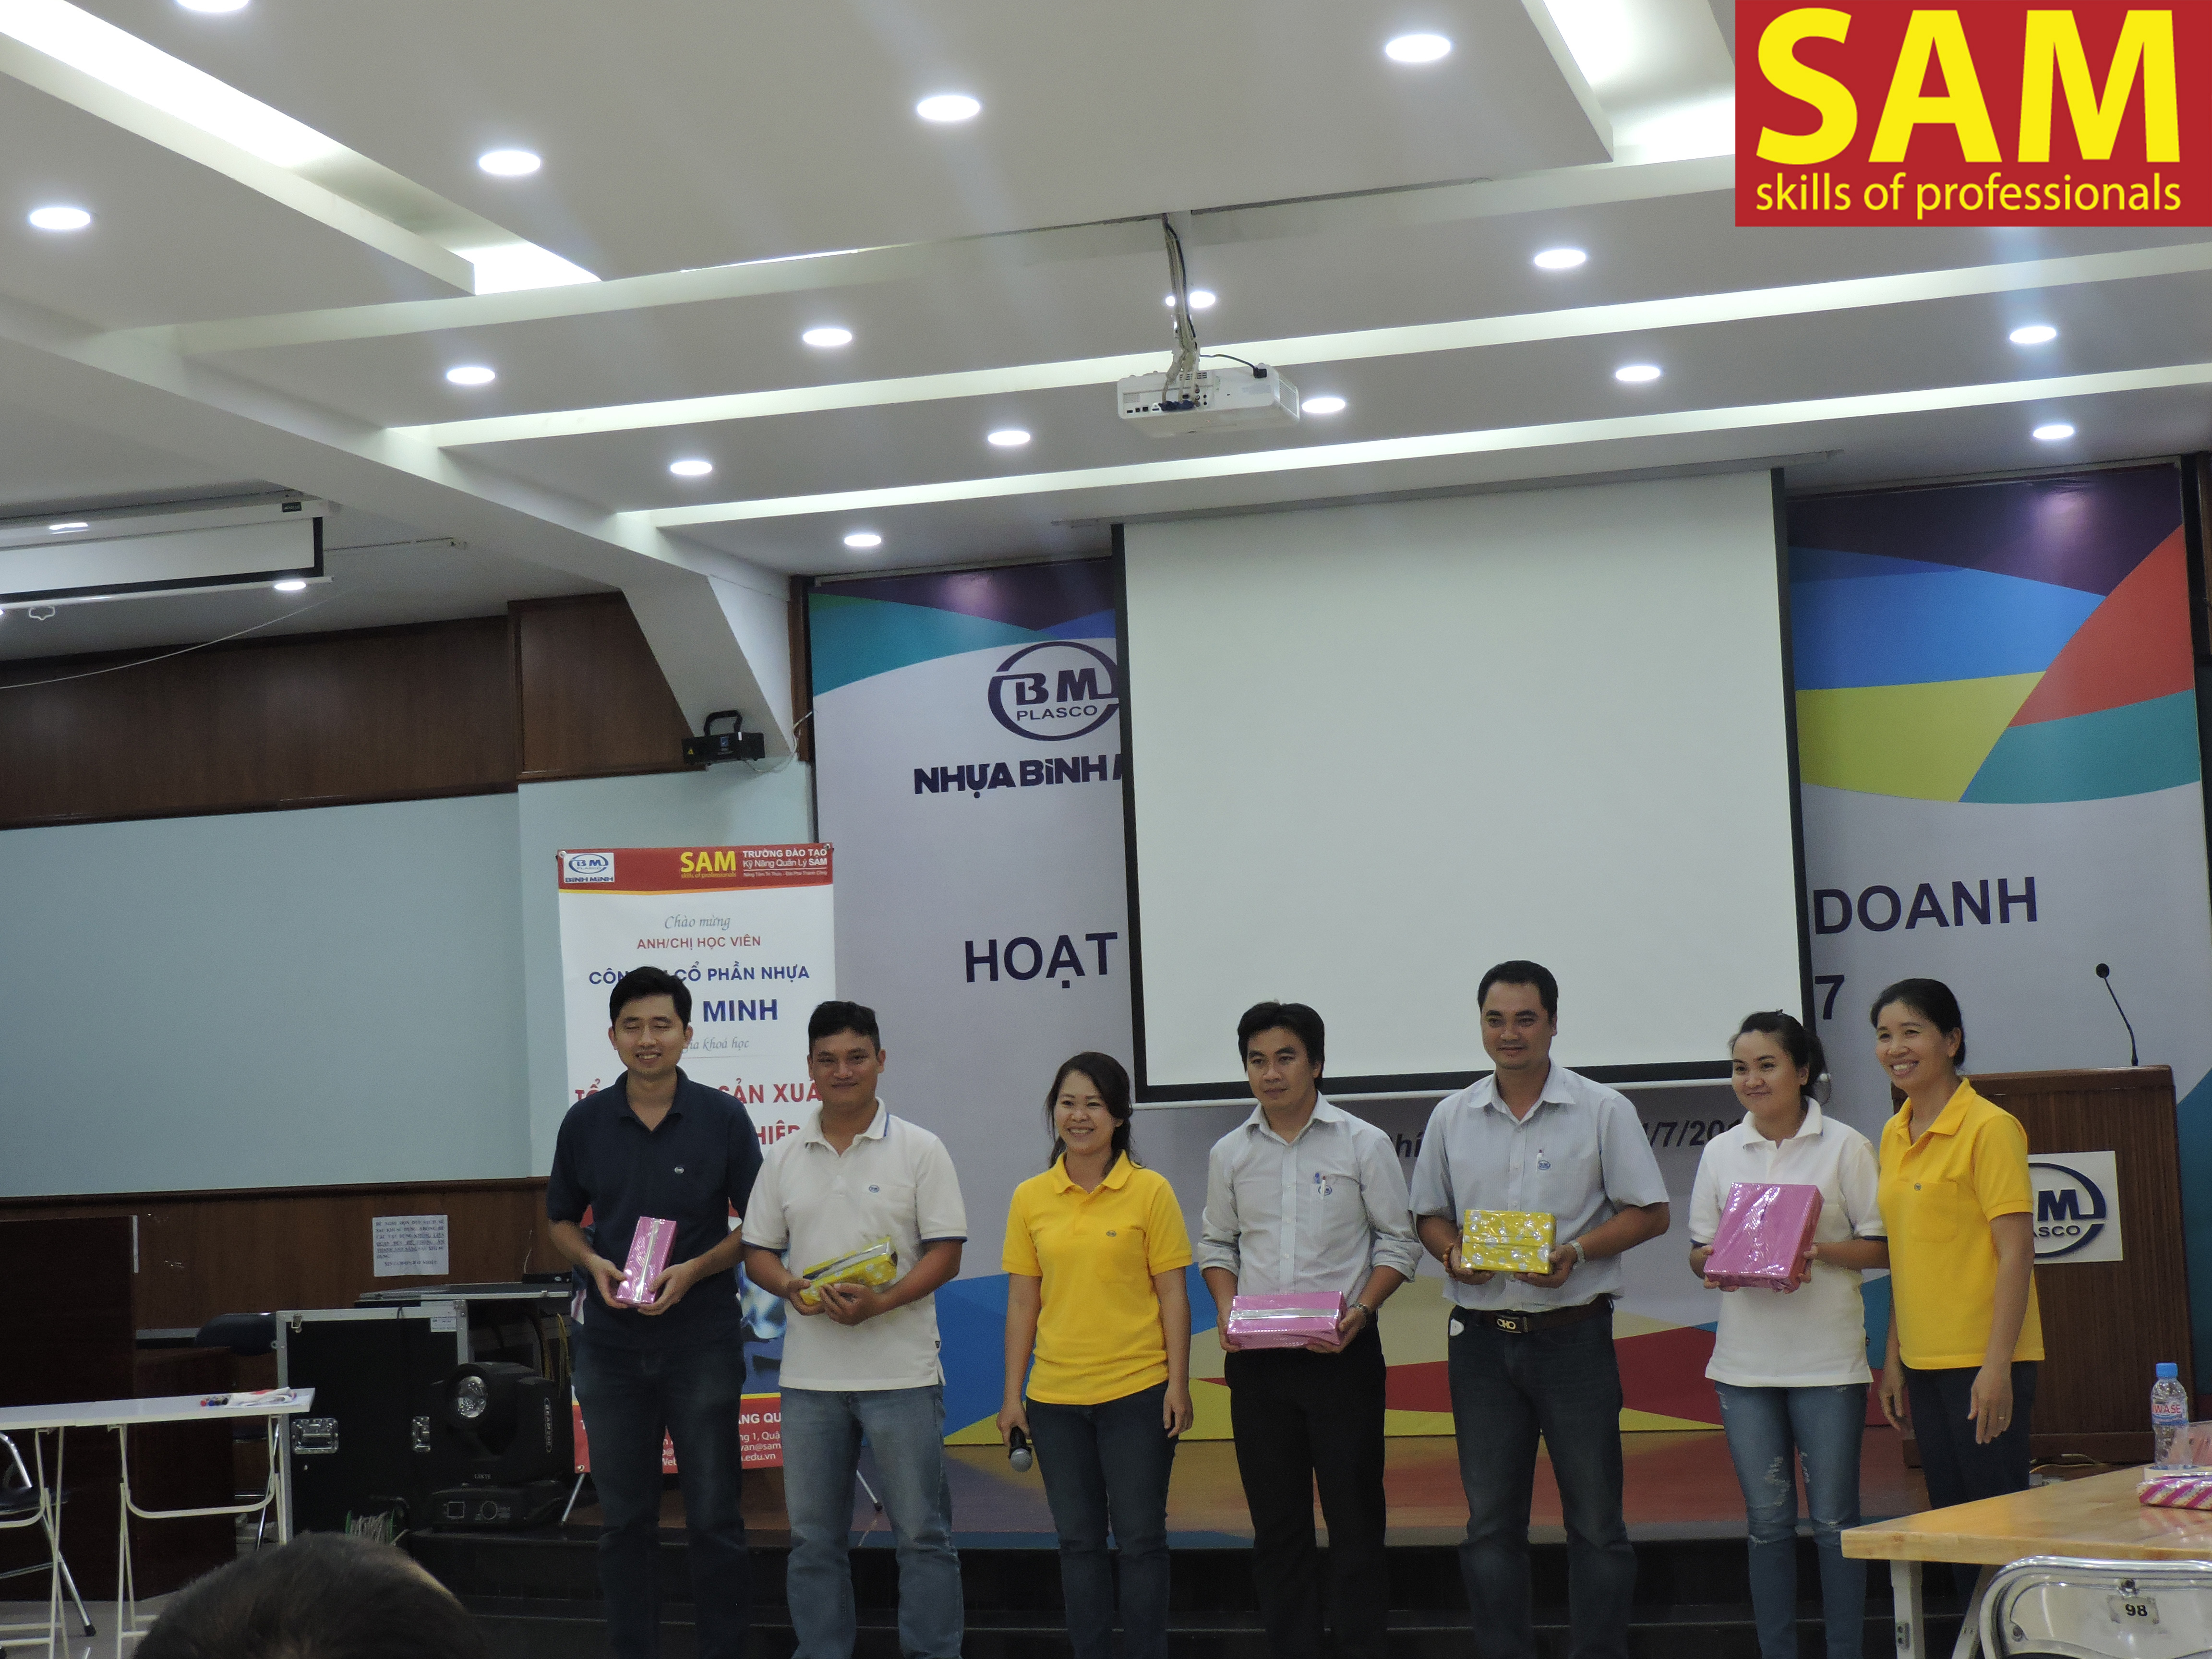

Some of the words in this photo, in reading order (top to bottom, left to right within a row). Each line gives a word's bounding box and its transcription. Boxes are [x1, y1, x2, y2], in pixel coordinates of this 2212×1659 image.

[1015, 668, 1098, 706] BM
[1016, 705, 1098, 721] PLASCO
[681, 851, 736, 873] SAM
[664, 914, 696, 929] Chào
[699, 914, 731, 931] mừng
[965, 931, 1118, 989] HOẠT
[1813, 876, 2037, 935] DOANH
[637, 938, 693, 950] ANH/CHỊ
[697, 937, 726, 950] HỌC
[730, 934, 761, 946] VIÊN
[674, 961, 701, 982] CỔ
[708, 961, 755, 981] PHẦN
[761, 963, 810, 983] NHỰA
[1815, 974, 1845, 1020] 7
[703, 999, 778, 1022] MINH
[731, 1036, 749, 1051] học
[2033, 1225, 2080, 1238] SCO
[741, 1452, 776, 1462] .edu.vn
[2125, 1603, 2148, 1617] 98
